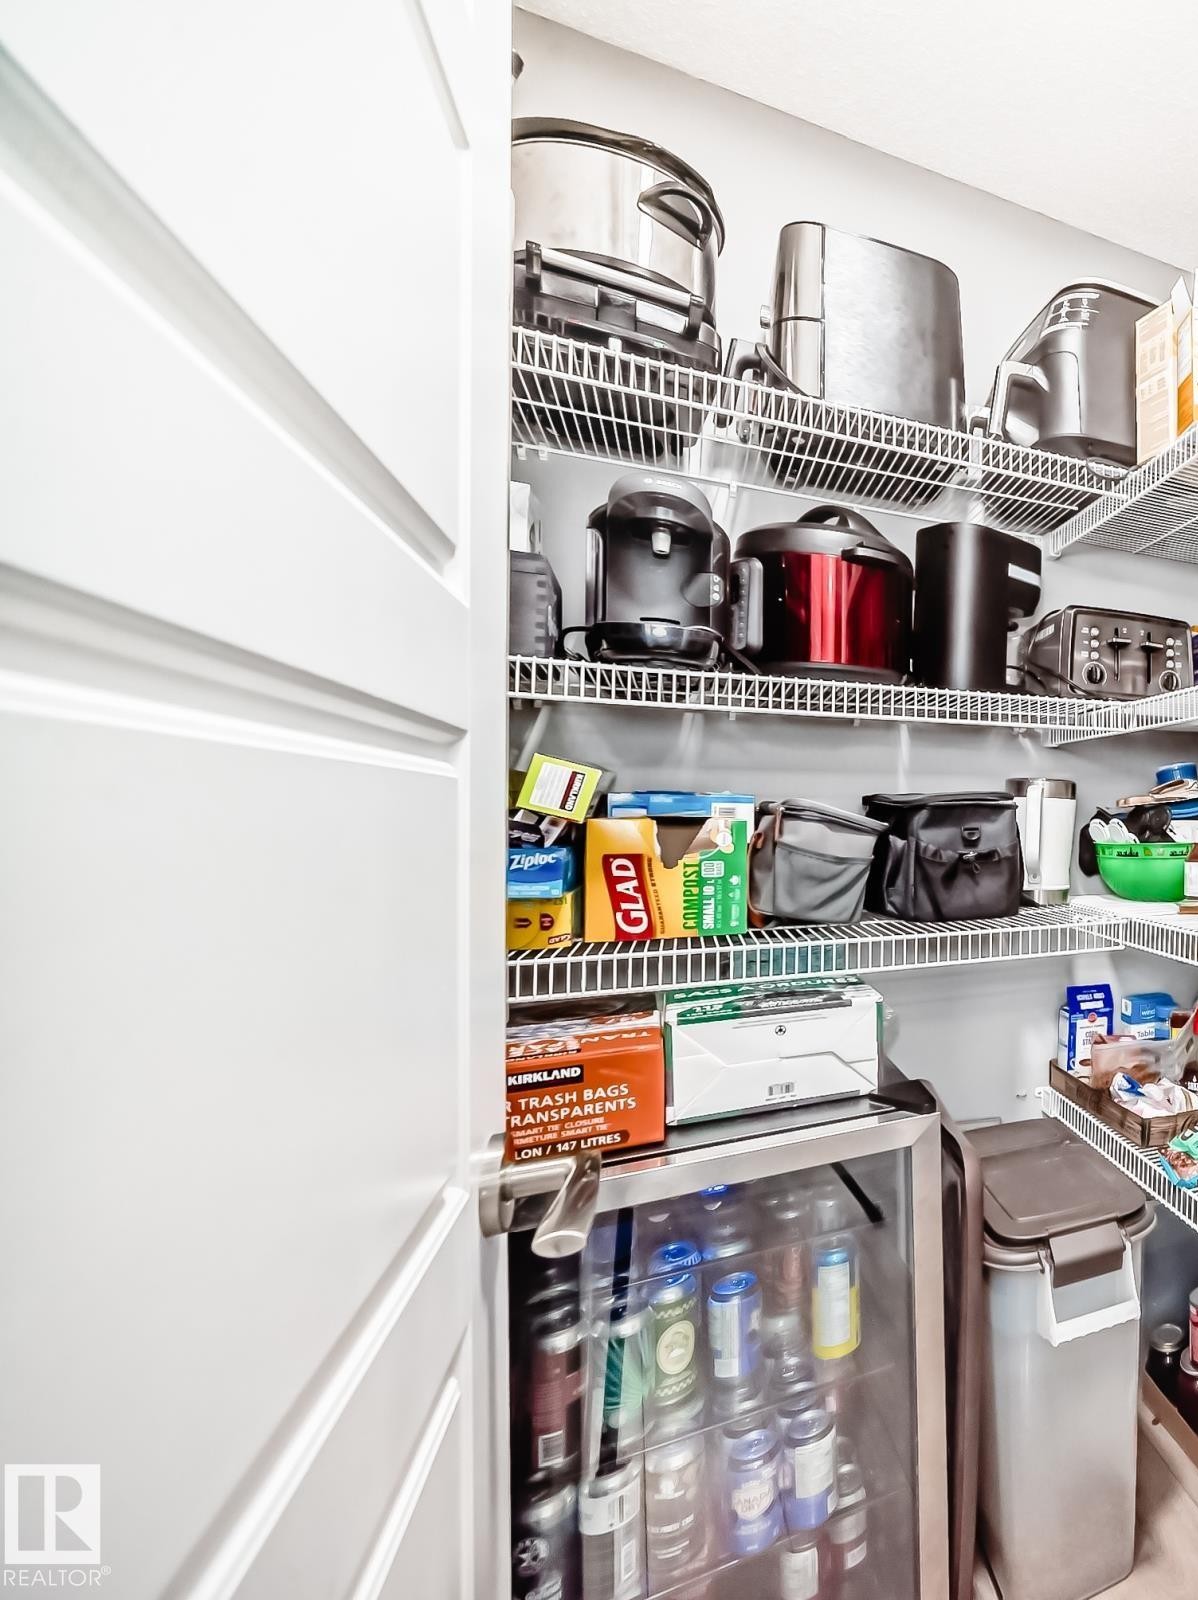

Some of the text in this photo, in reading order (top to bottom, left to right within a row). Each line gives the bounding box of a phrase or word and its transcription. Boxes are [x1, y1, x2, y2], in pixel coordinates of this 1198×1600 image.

[510, 852, 557, 871] Ziploc
[611, 857, 649, 934] GLAD
[682, 862, 699, 930] COMPOST
[703, 898, 715, 930] SMALL
[1137, 1028, 1155, 1038] Table
[507, 1066, 582, 1087] KIRKLAND
[518, 1091, 577, 1111] TRASH
[583, 1083, 629, 1101] BAGS
[564, 1117, 606, 1129] CLOSURE
[514, 1147, 543, 1161] LON
[556, 1141, 577, 1153] 147
[580, 1133, 622, 1149] LITRES
